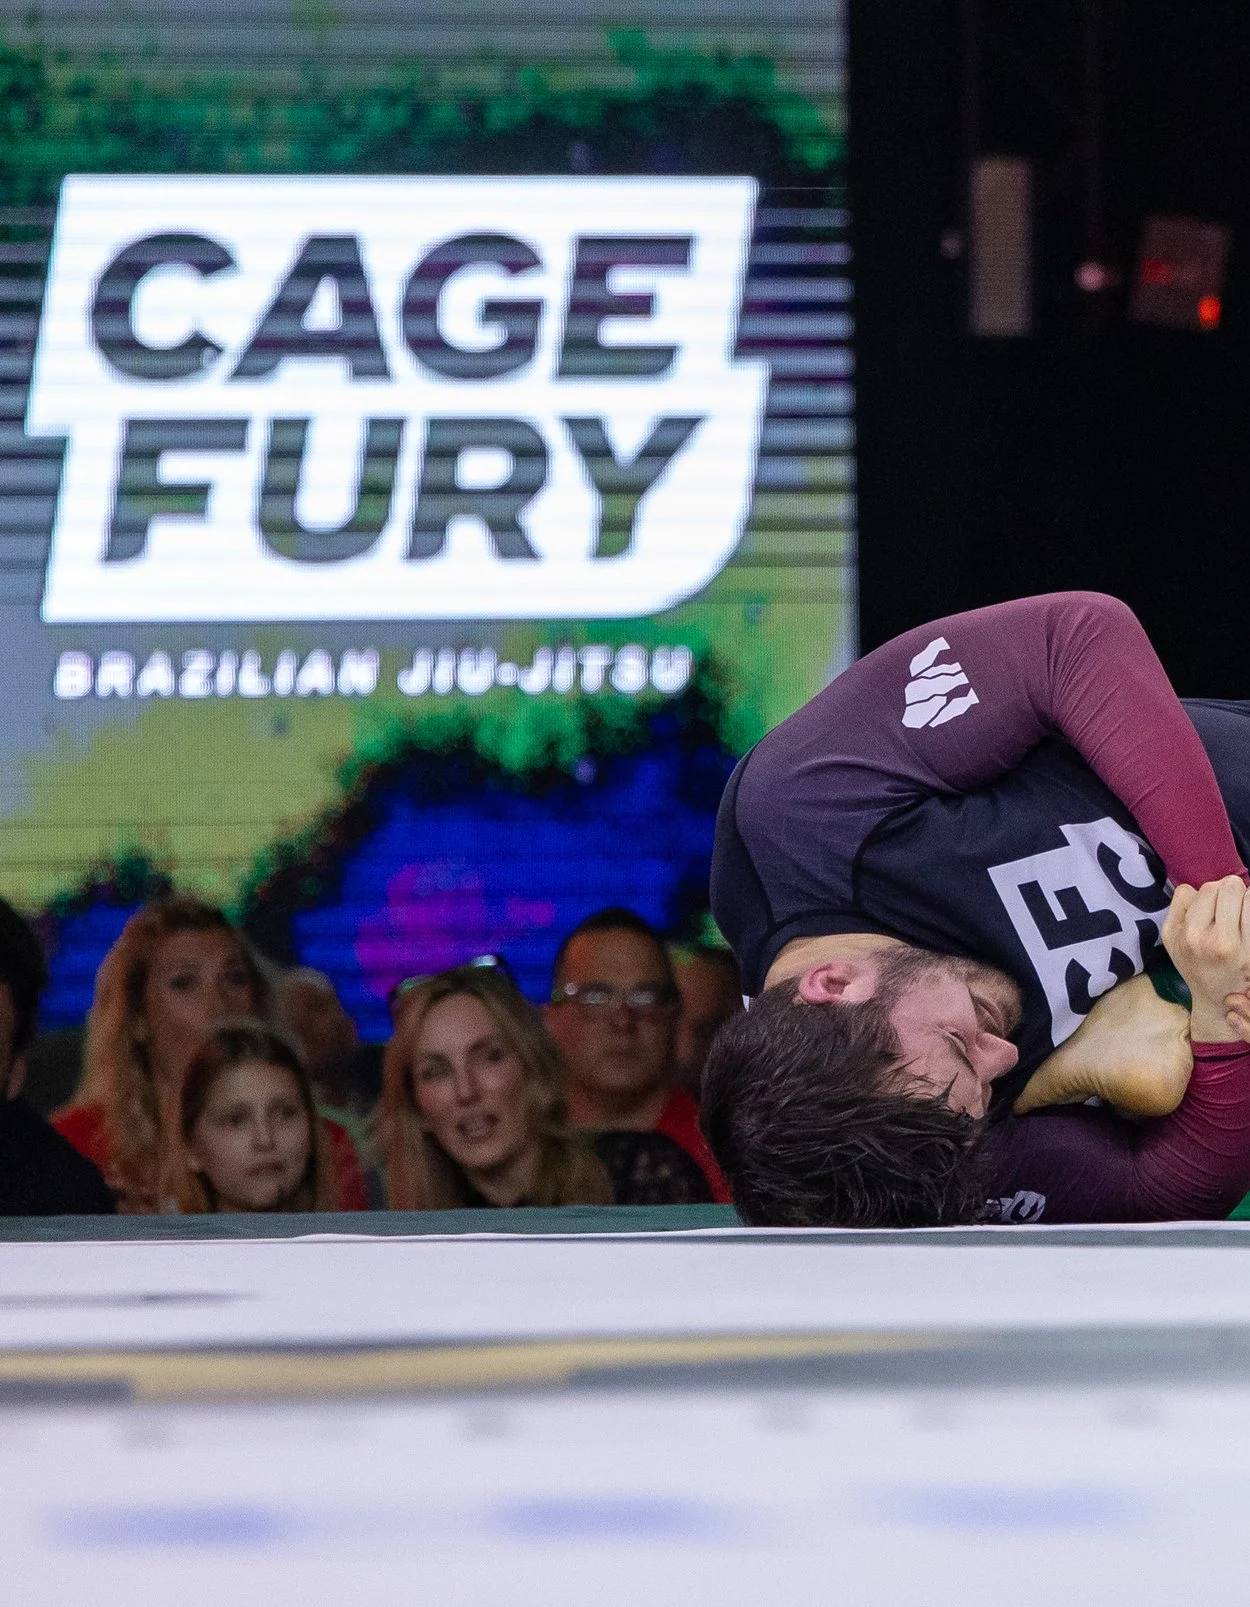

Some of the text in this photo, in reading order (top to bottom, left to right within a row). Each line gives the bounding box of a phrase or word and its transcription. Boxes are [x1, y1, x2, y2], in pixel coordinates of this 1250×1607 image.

[89, 231, 696, 383] CAGE
[101, 417, 708, 563] FURY
[53, 645, 692, 699] BRAZILIAN JIU-JITSU
